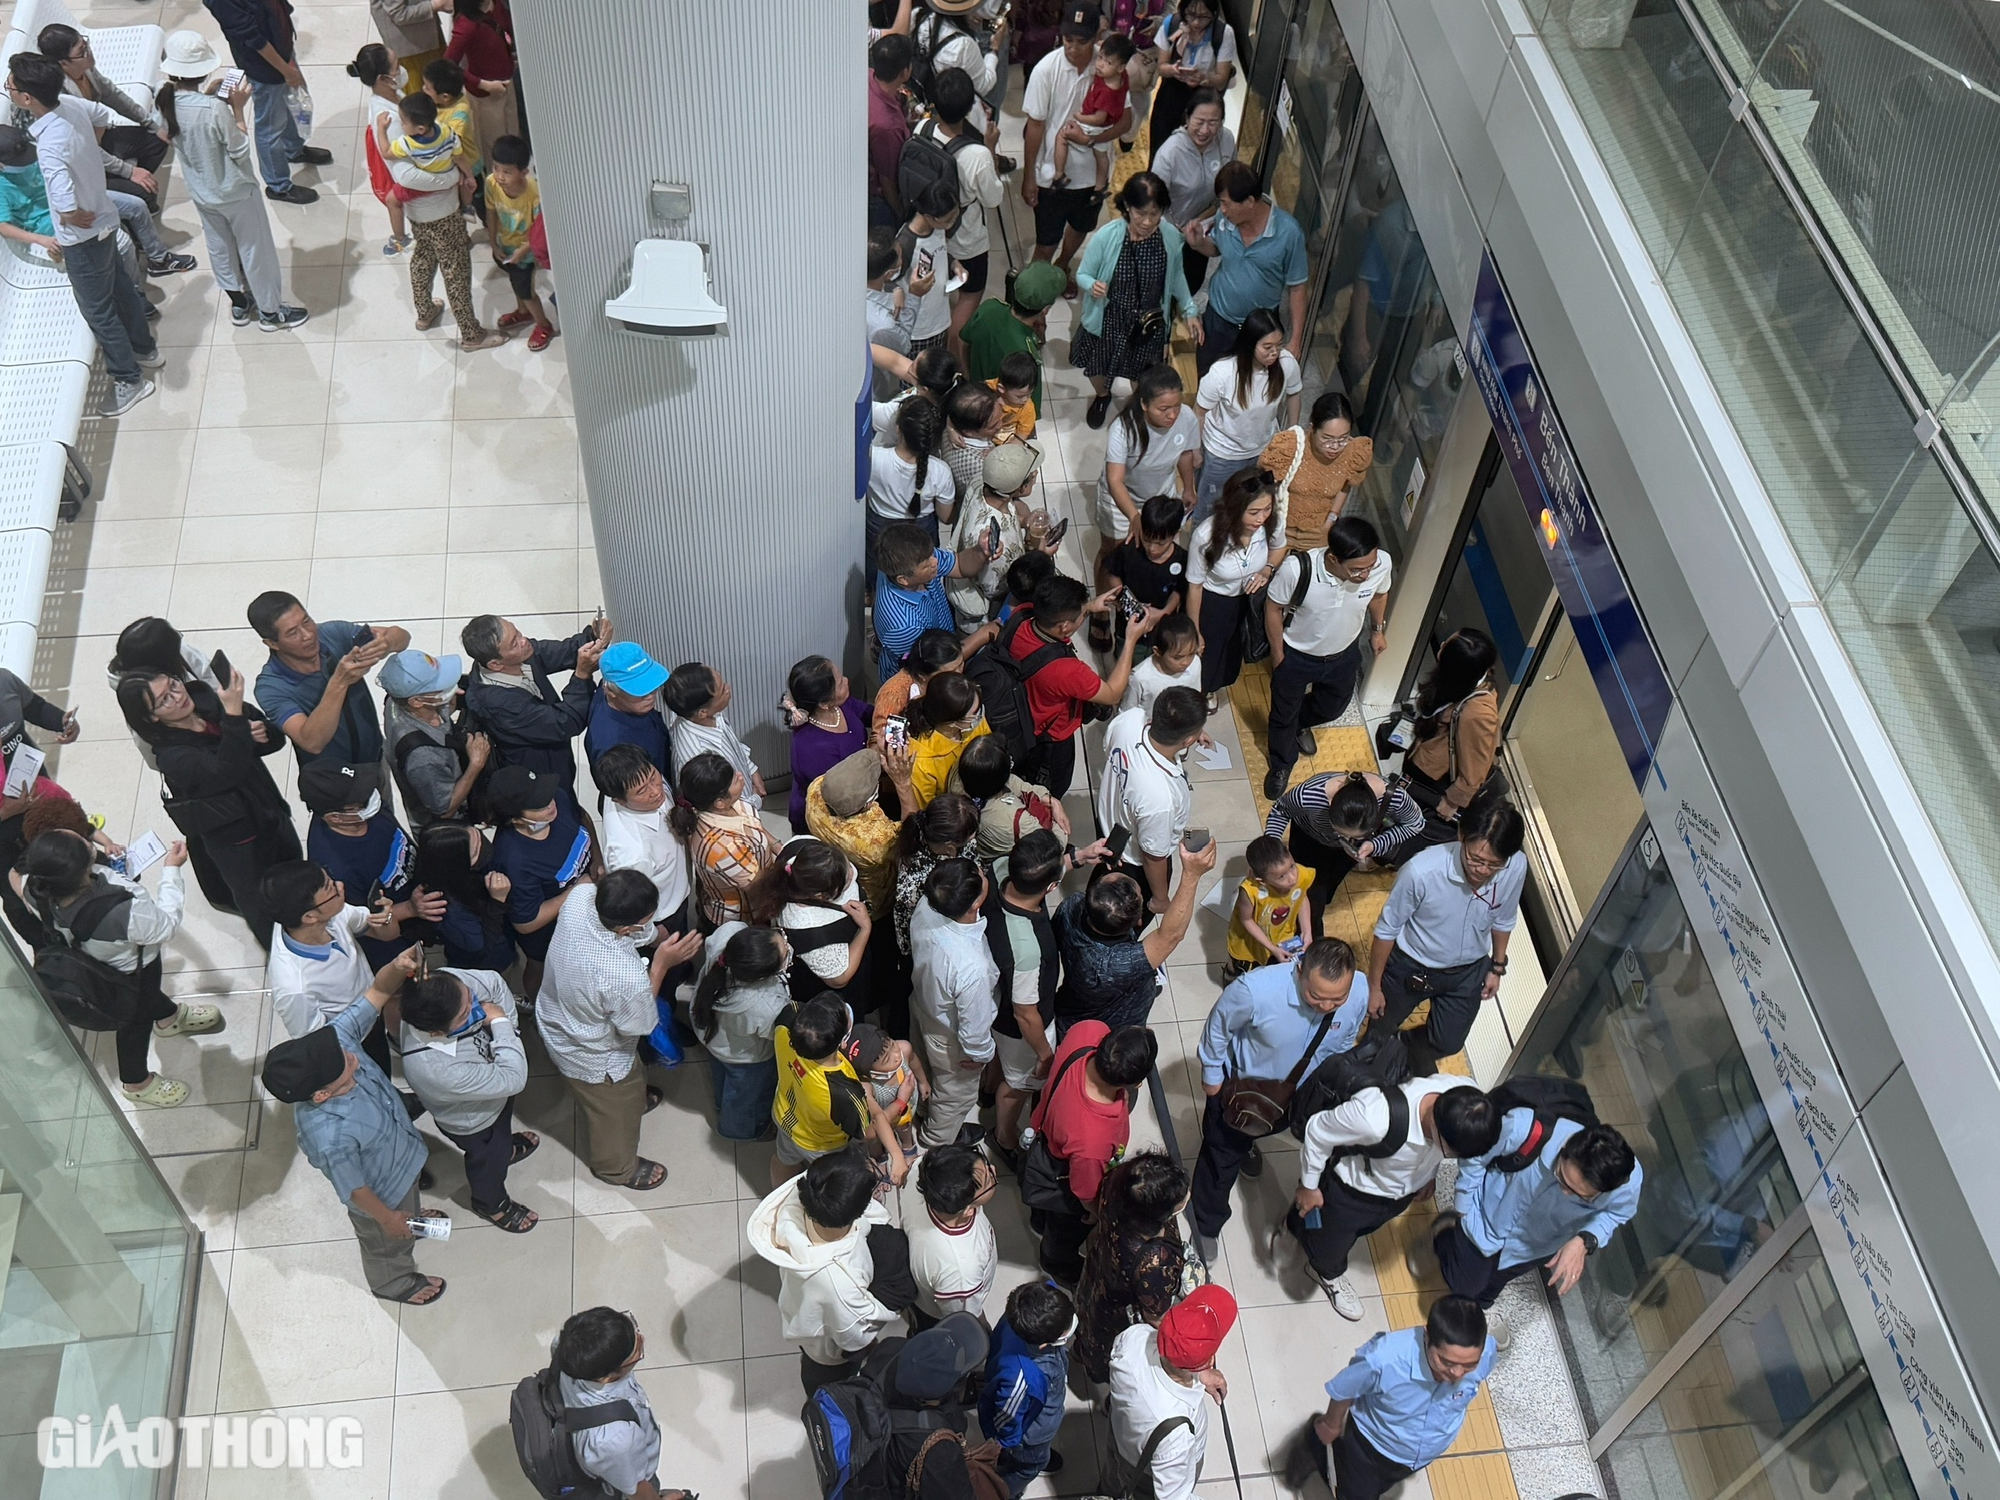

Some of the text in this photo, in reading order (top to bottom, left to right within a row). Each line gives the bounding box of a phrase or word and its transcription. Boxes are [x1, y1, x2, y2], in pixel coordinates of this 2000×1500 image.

[1540, 410, 1587, 532] Bến Thành
[1541, 452, 1575, 537] Ben Thanh
[1682, 800, 1691, 816] Bến
[1691, 808, 1698, 820] Xe
[1720, 862, 1732, 880] Quốc
[1732, 874, 1742, 888] Gia
[1720, 892, 1730, 909] Khu
[1730, 902, 1744, 924] Công
[1760, 928, 1770, 946] Cao
[1782, 1042, 1816, 1086] Phước Long
[1836, 1174, 1846, 1190] An
[1910, 1356, 1928, 1386] Công
[1939, 1424, 1964, 1462] Ba Son
